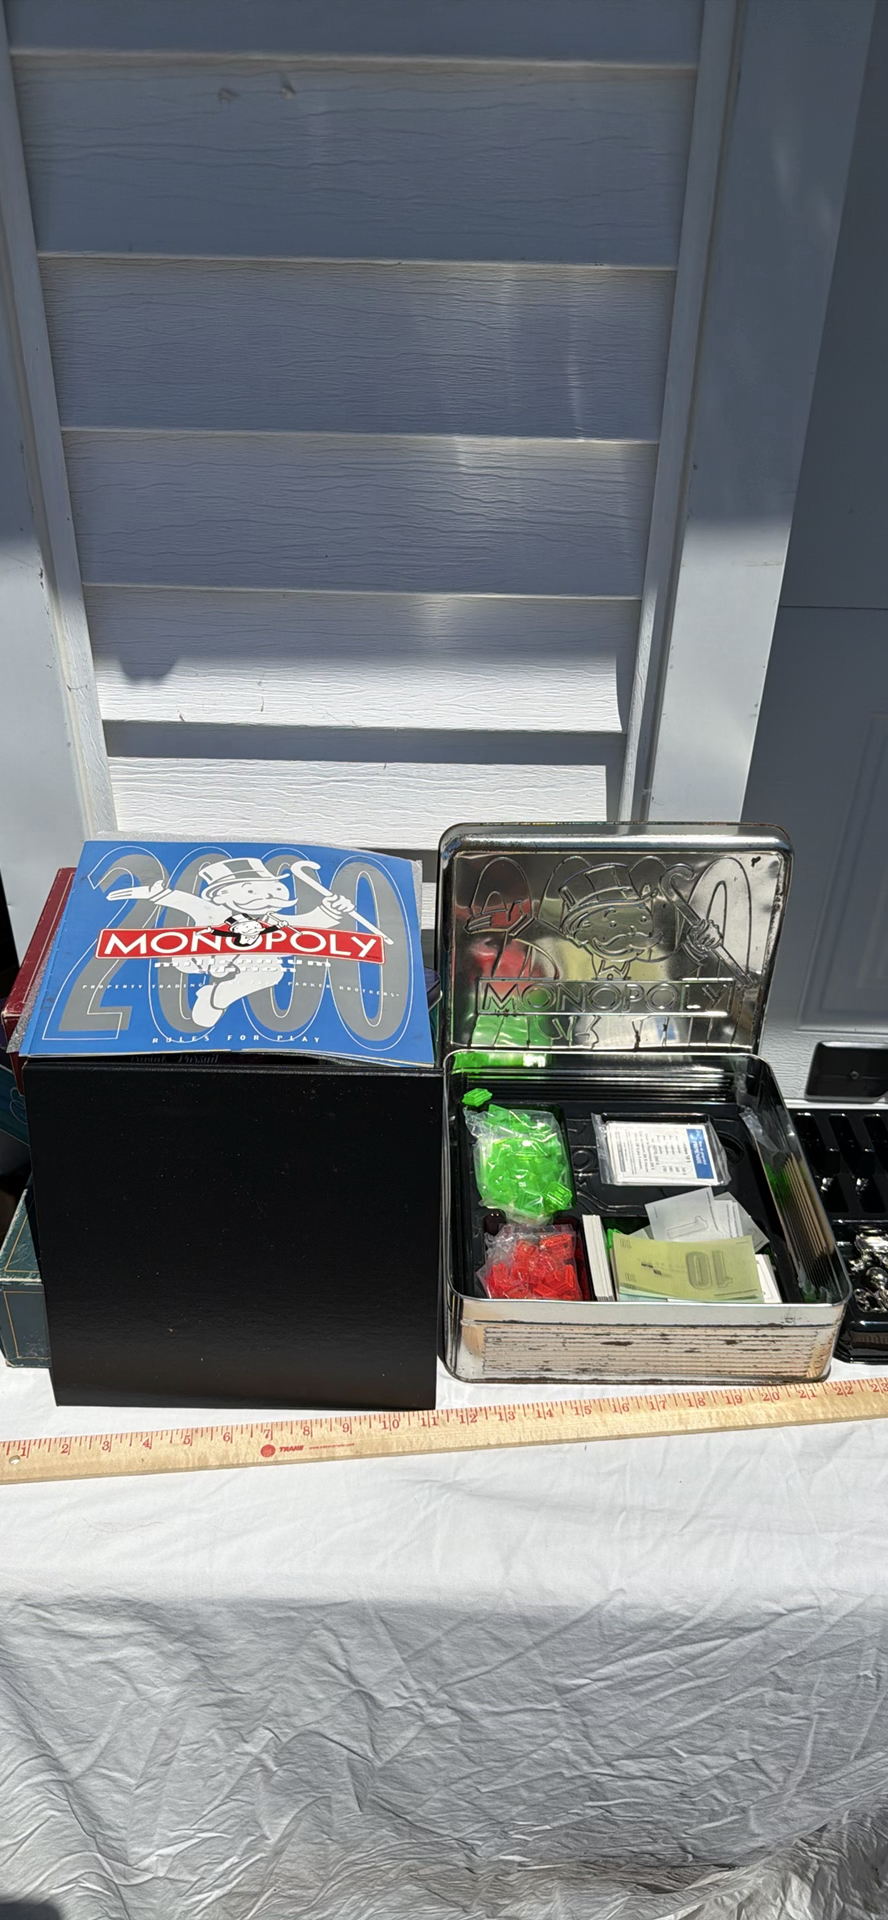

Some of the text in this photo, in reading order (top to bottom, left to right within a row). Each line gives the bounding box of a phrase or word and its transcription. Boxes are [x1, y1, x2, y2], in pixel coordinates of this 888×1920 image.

[104, 931, 377, 957] MONOPOLY
[288, 981, 331, 989] PARKER
[482, 982, 729, 1012] MONOPOLY
[152, 1035, 210, 1044] RULES
[277, 1035, 320, 1043] PLAY
[685, 1250, 733, 1289] 10
[20, 1447, 28, 1456] 1
[61, 1444, 69, 1454] 2
[102, 1441, 110, 1451] 3
[142, 1438, 150, 1448] 4
[183, 1434, 191, 1445] 5
[223, 1432, 231, 1442] 6
[263, 1429, 271, 1439] 7
[302, 1426, 310, 1436] 8
[342, 1422, 350, 1432] 9
[382, 1419, 399, 1430] 10
[421, 1416, 438, 1427] 11
[459, 1413, 477, 1424] 12
[499, 1410, 516, 1421] 13
[536, 1408, 553, 1419] 14
[574, 1404, 592, 1416] 15
[612, 1402, 630, 1413] 16
[650, 1399, 667, 1411] 17
[687, 1397, 706, 1408] 18
[725, 1394, 743, 1405] 19
[762, 1391, 780, 1402] 20
[799, 1389, 817, 1399] 21
[836, 1386, 854, 1396] 22
